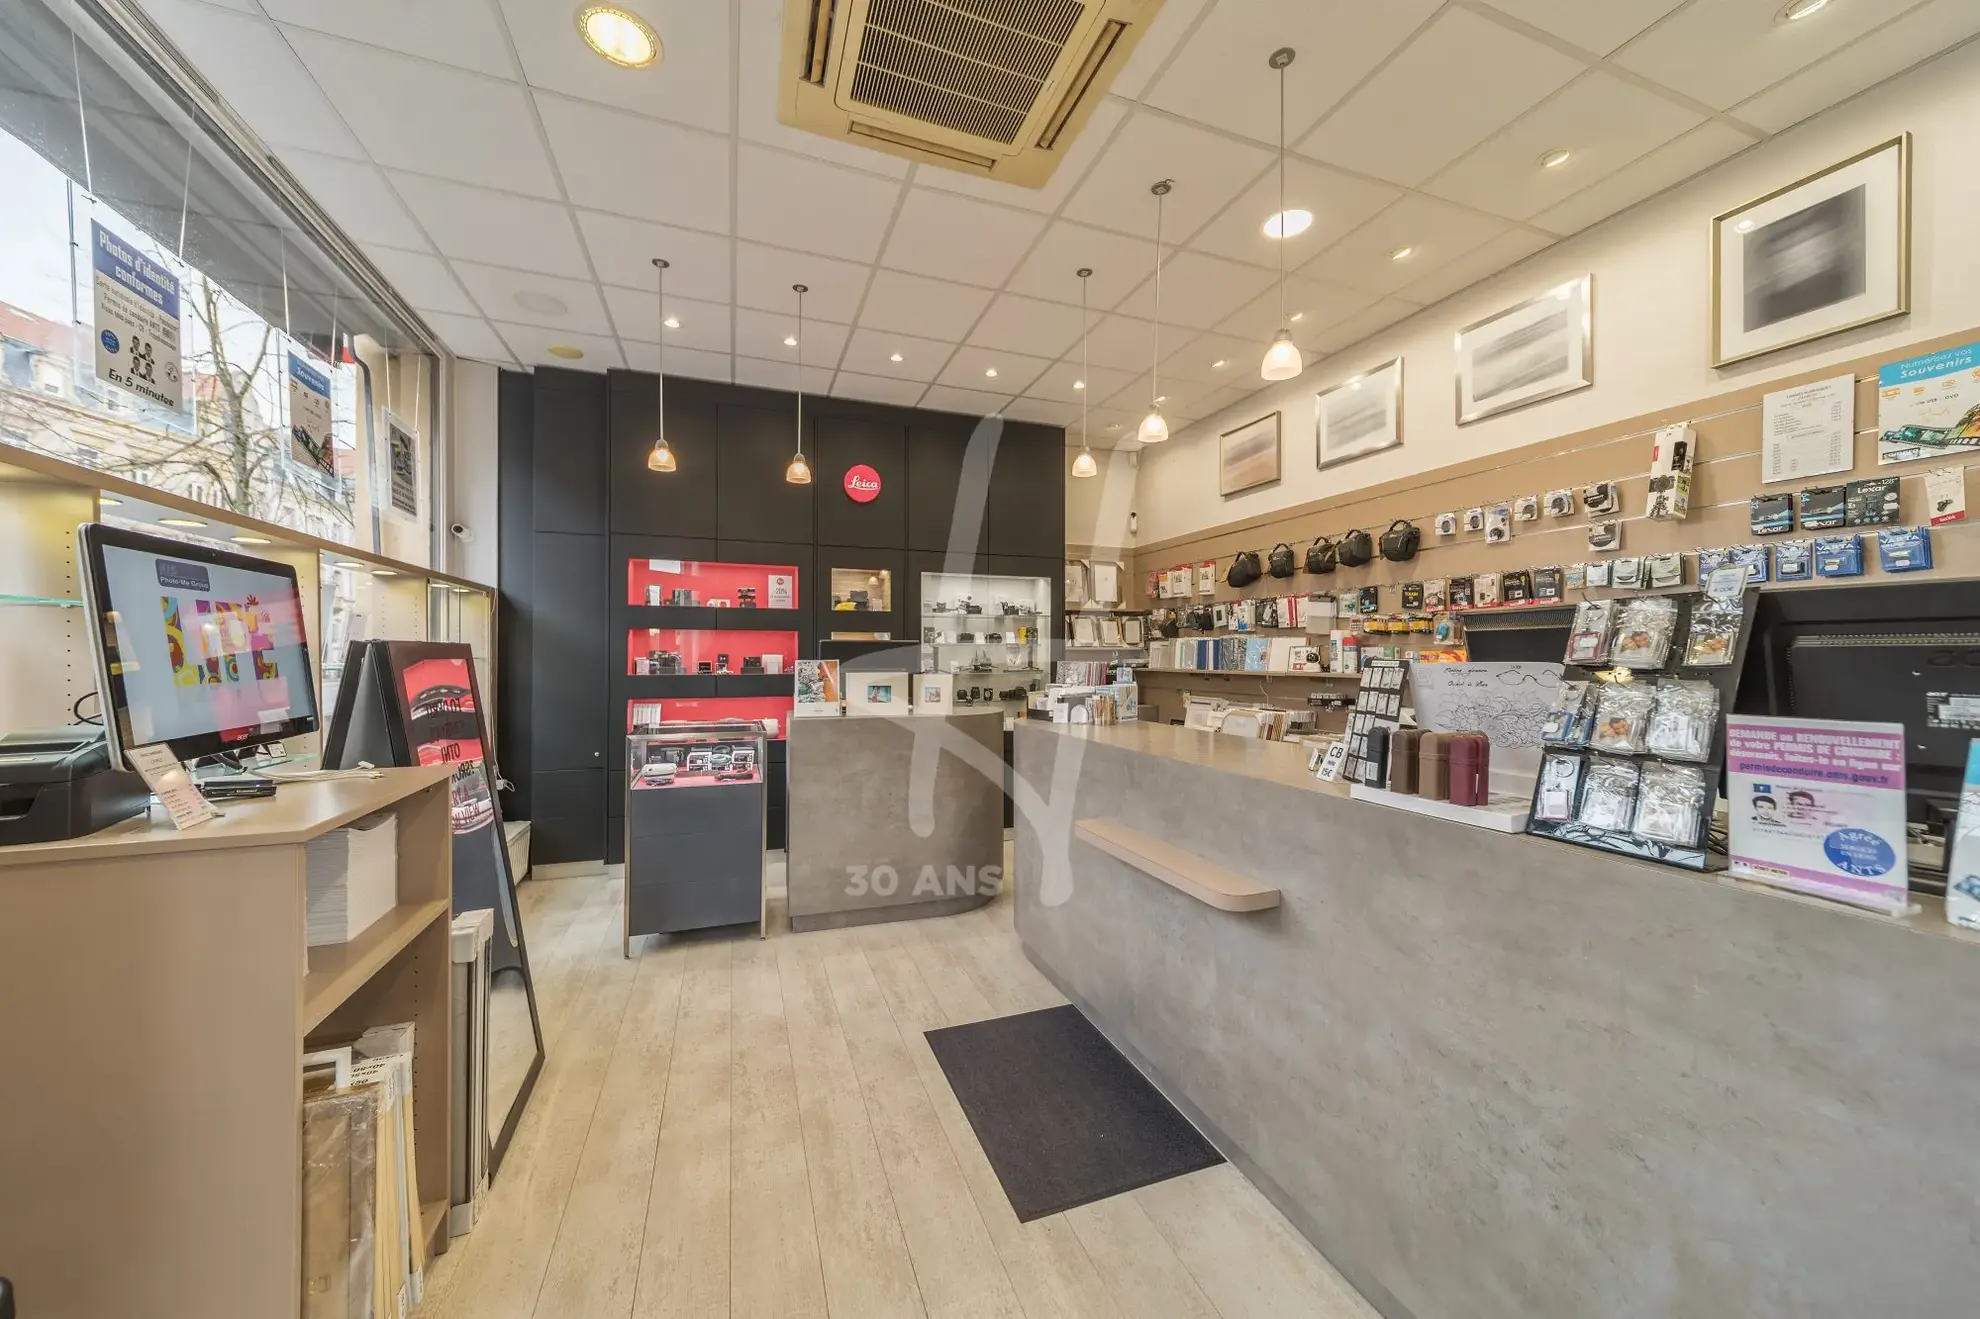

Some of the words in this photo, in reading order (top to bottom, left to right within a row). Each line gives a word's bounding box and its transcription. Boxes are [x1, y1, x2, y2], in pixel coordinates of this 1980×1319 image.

[100, 230, 133, 267] Photos
[135, 257, 175, 295] d'identité
[115, 266, 163, 304] conformes
[1955, 348, 1972, 357] vos
[1900, 356, 1972, 379] Souvenirs
[109, 368, 122, 384] En
[125, 376, 134, 388] 5
[135, 384, 174, 407] minutes
[847, 475, 879, 491] Leica
[1857, 484, 1888, 494] Lexar
[1757, 525, 1784, 535] Lexar
[1880, 534, 1919, 544] VARTA
[1816, 542, 1854, 551] VARTA
[160, 576, 189, 587] Photo-Me
[191, 580, 209, 589] Group
[1729, 729, 1777, 741] DEMANDE
[1796, 733, 1901, 749] RENOUVELLEMENT
[1330, 746, 1344, 759] CB
[1729, 739, 1741, 748] de
[1745, 741, 1771, 750] votre
[1774, 742, 1814, 753] PERMIS
[1817, 745, 1831, 755] DE
[1835, 746, 1892, 760] CONDUIRE
